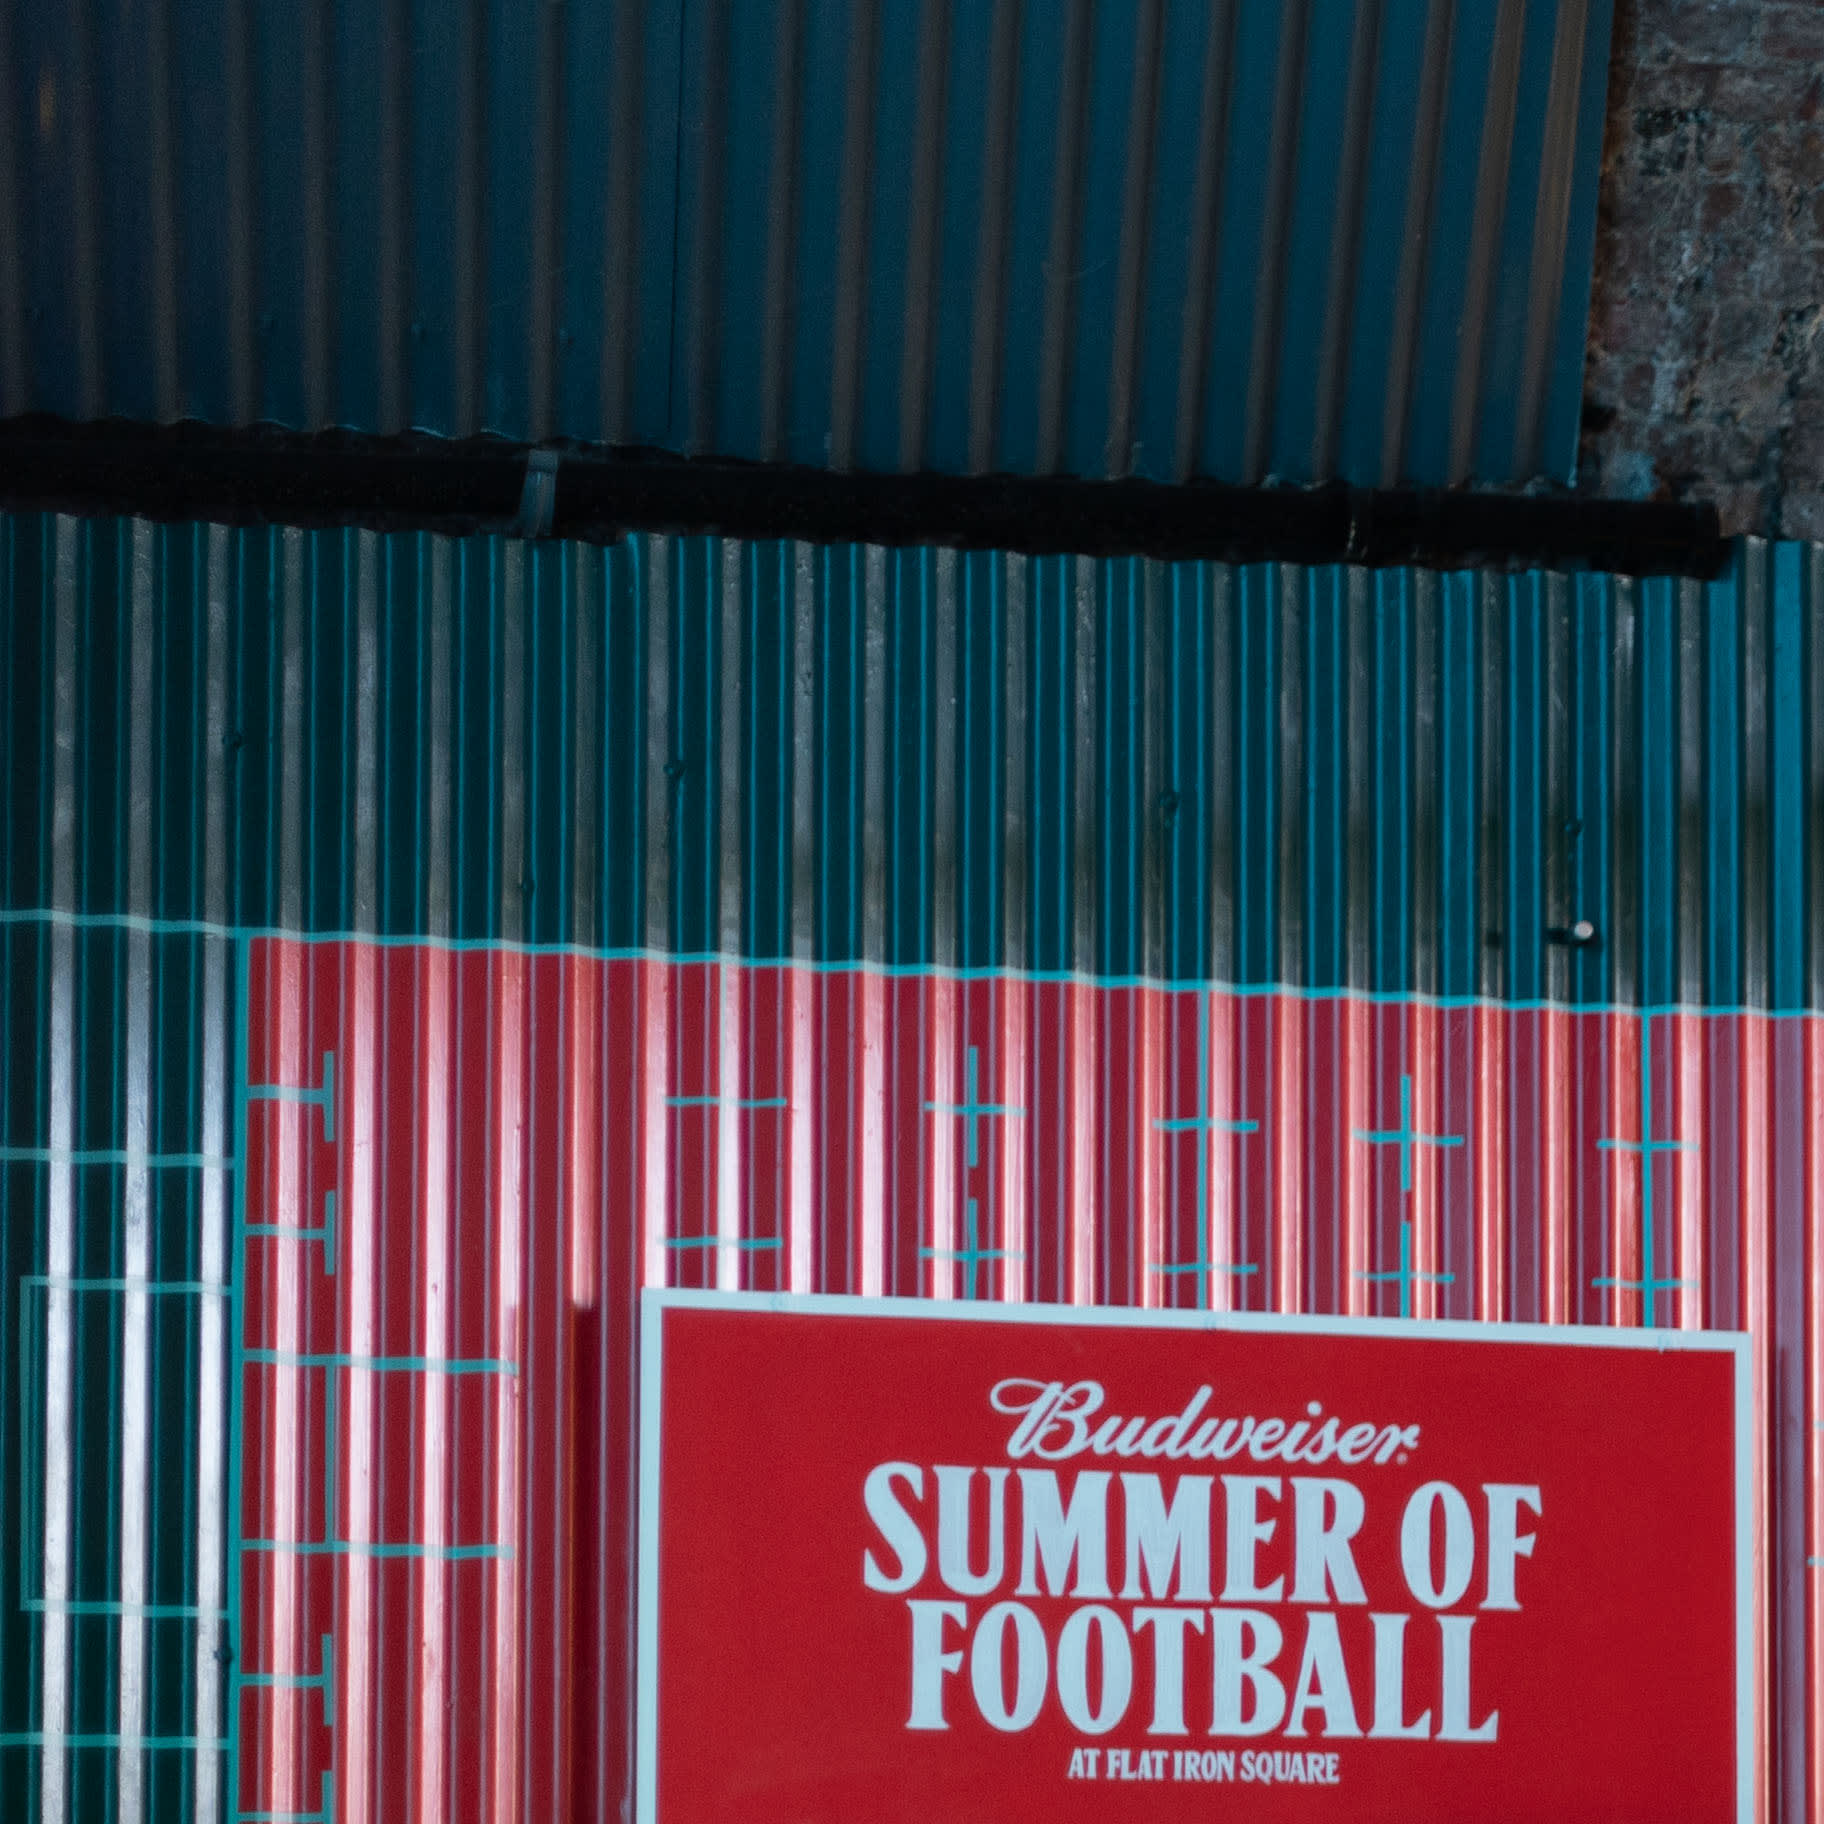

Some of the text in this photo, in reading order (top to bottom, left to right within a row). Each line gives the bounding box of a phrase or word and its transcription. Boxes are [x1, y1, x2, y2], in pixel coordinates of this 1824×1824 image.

[990, 1378, 1421, 1463] Budweiser
[863, 1462, 1543, 1612] SUMMER OF
[905, 1599, 1499, 1742] FOOTBALL
[1067, 1748, 1340, 1785] AT FLAT IRON SQUARE
